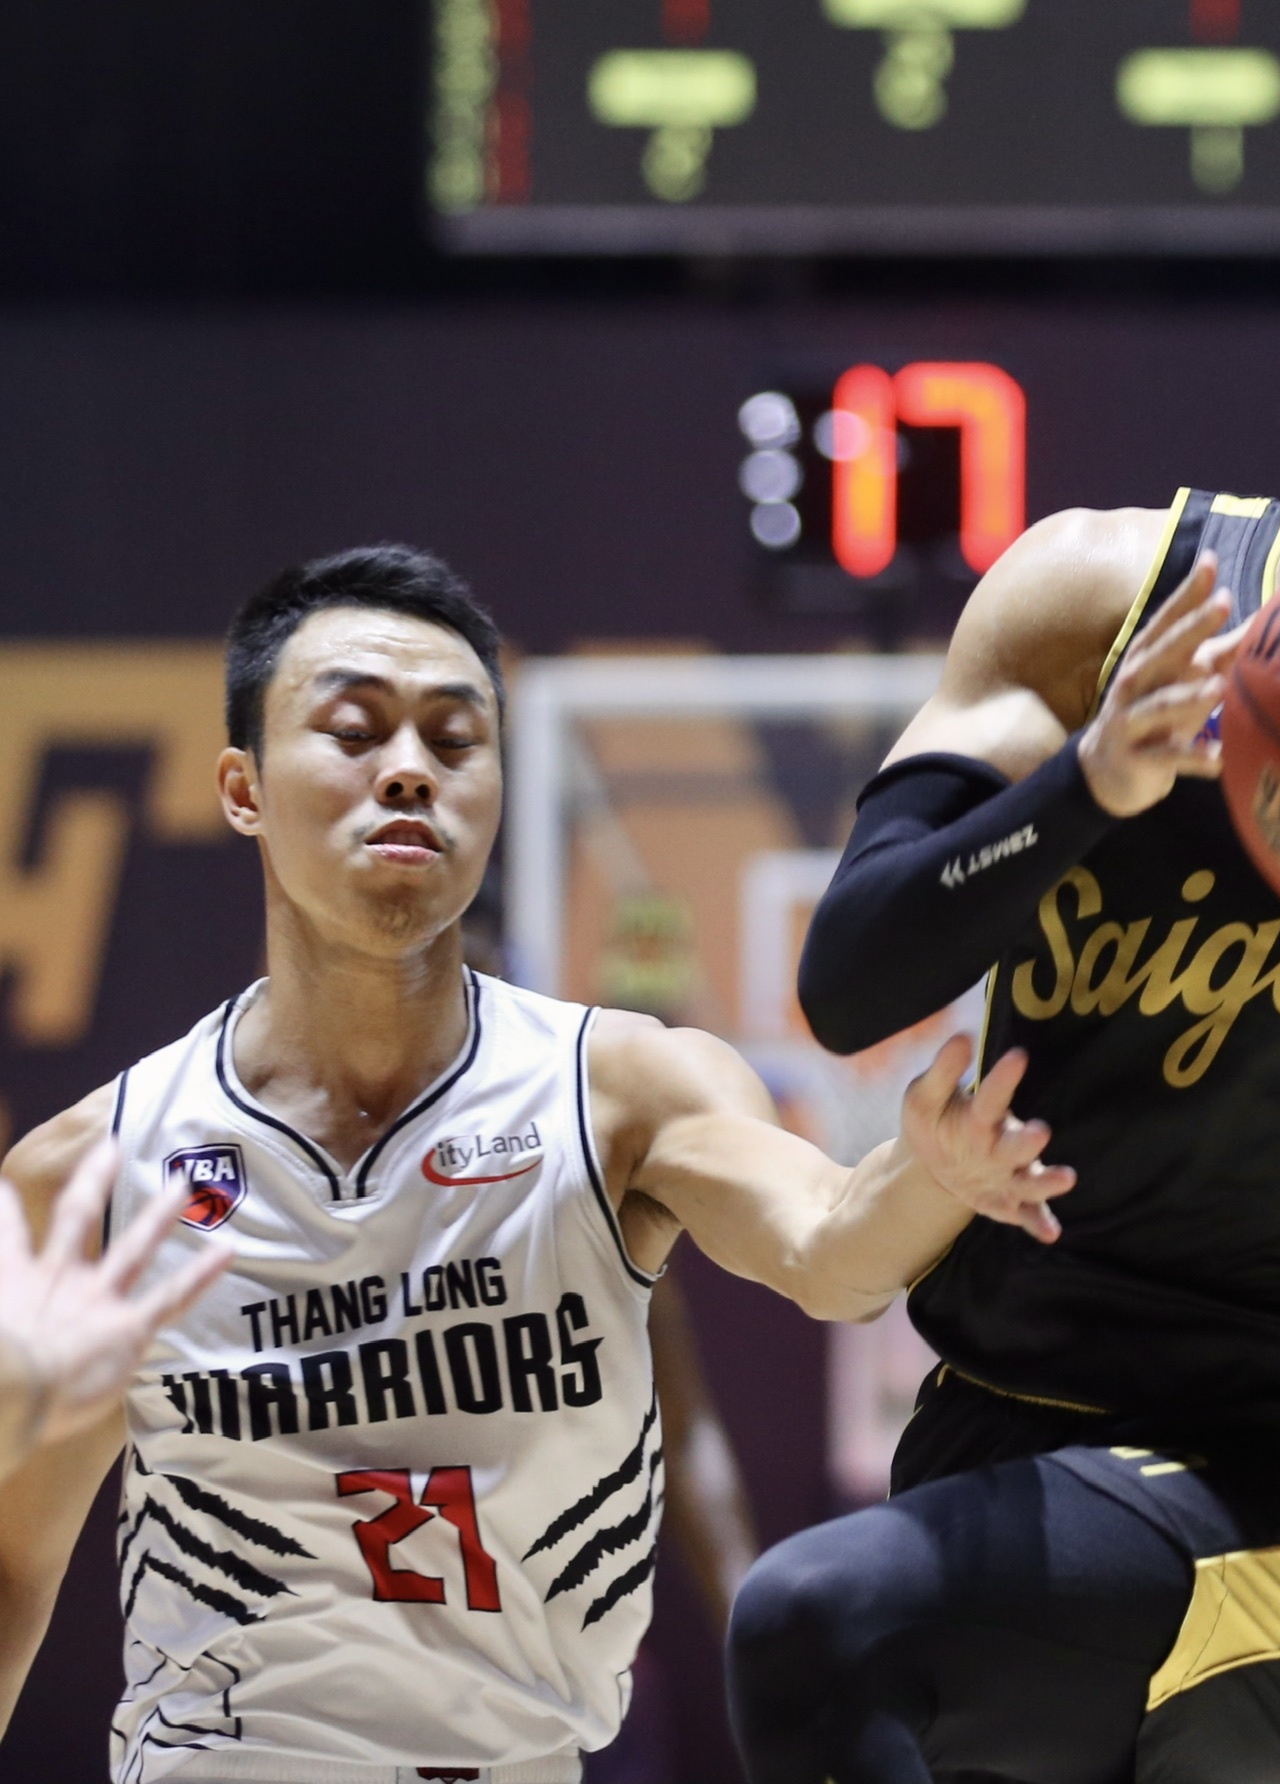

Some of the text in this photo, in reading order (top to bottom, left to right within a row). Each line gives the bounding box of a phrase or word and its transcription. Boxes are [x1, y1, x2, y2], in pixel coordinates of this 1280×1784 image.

[832, 362, 1026, 578] 17
[162, 1292, 605, 1442] WARRIORS
[241, 1256, 508, 1353] THANG LONG
[335, 1465, 502, 1613] 21
